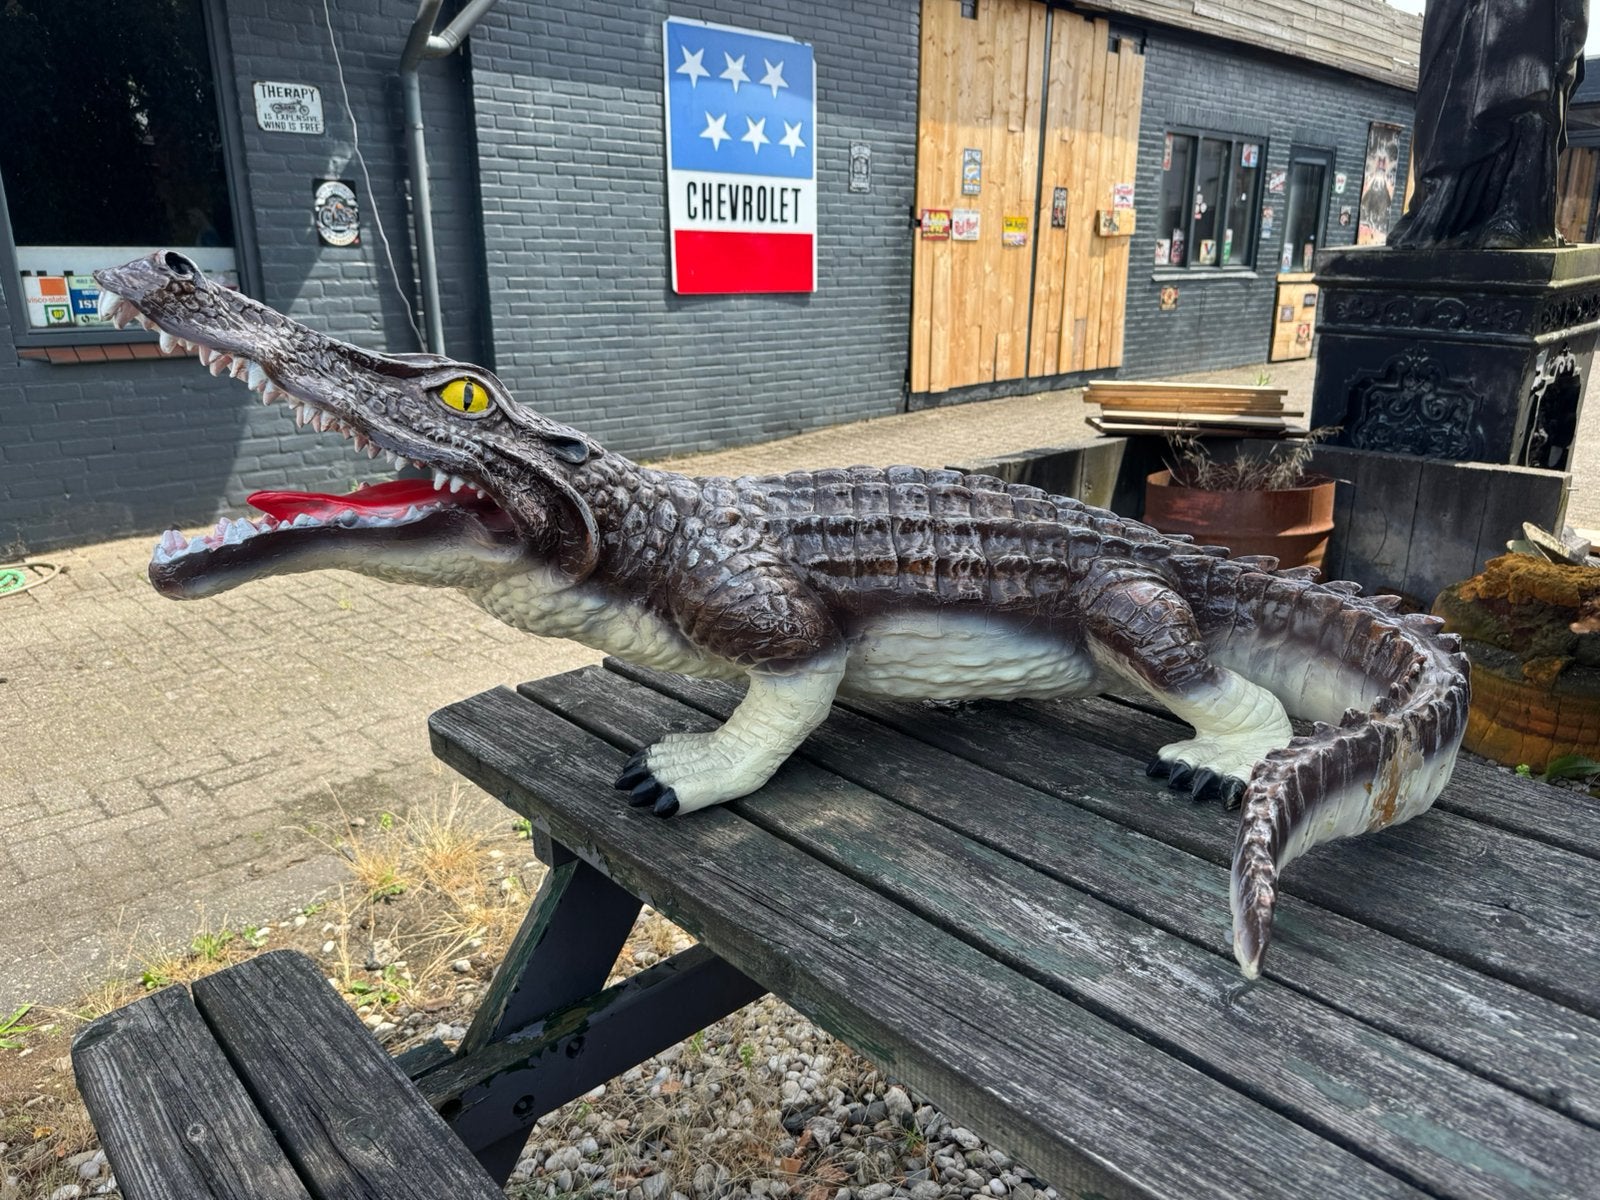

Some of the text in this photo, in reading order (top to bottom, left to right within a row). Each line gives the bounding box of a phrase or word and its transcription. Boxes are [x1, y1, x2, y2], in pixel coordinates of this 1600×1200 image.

[261, 85, 315, 102] THERAPY
[276, 113, 319, 123] EXPENSIVE
[263, 121, 320, 132] WIND IS FREE
[687, 181, 801, 224] CHEVROLET
